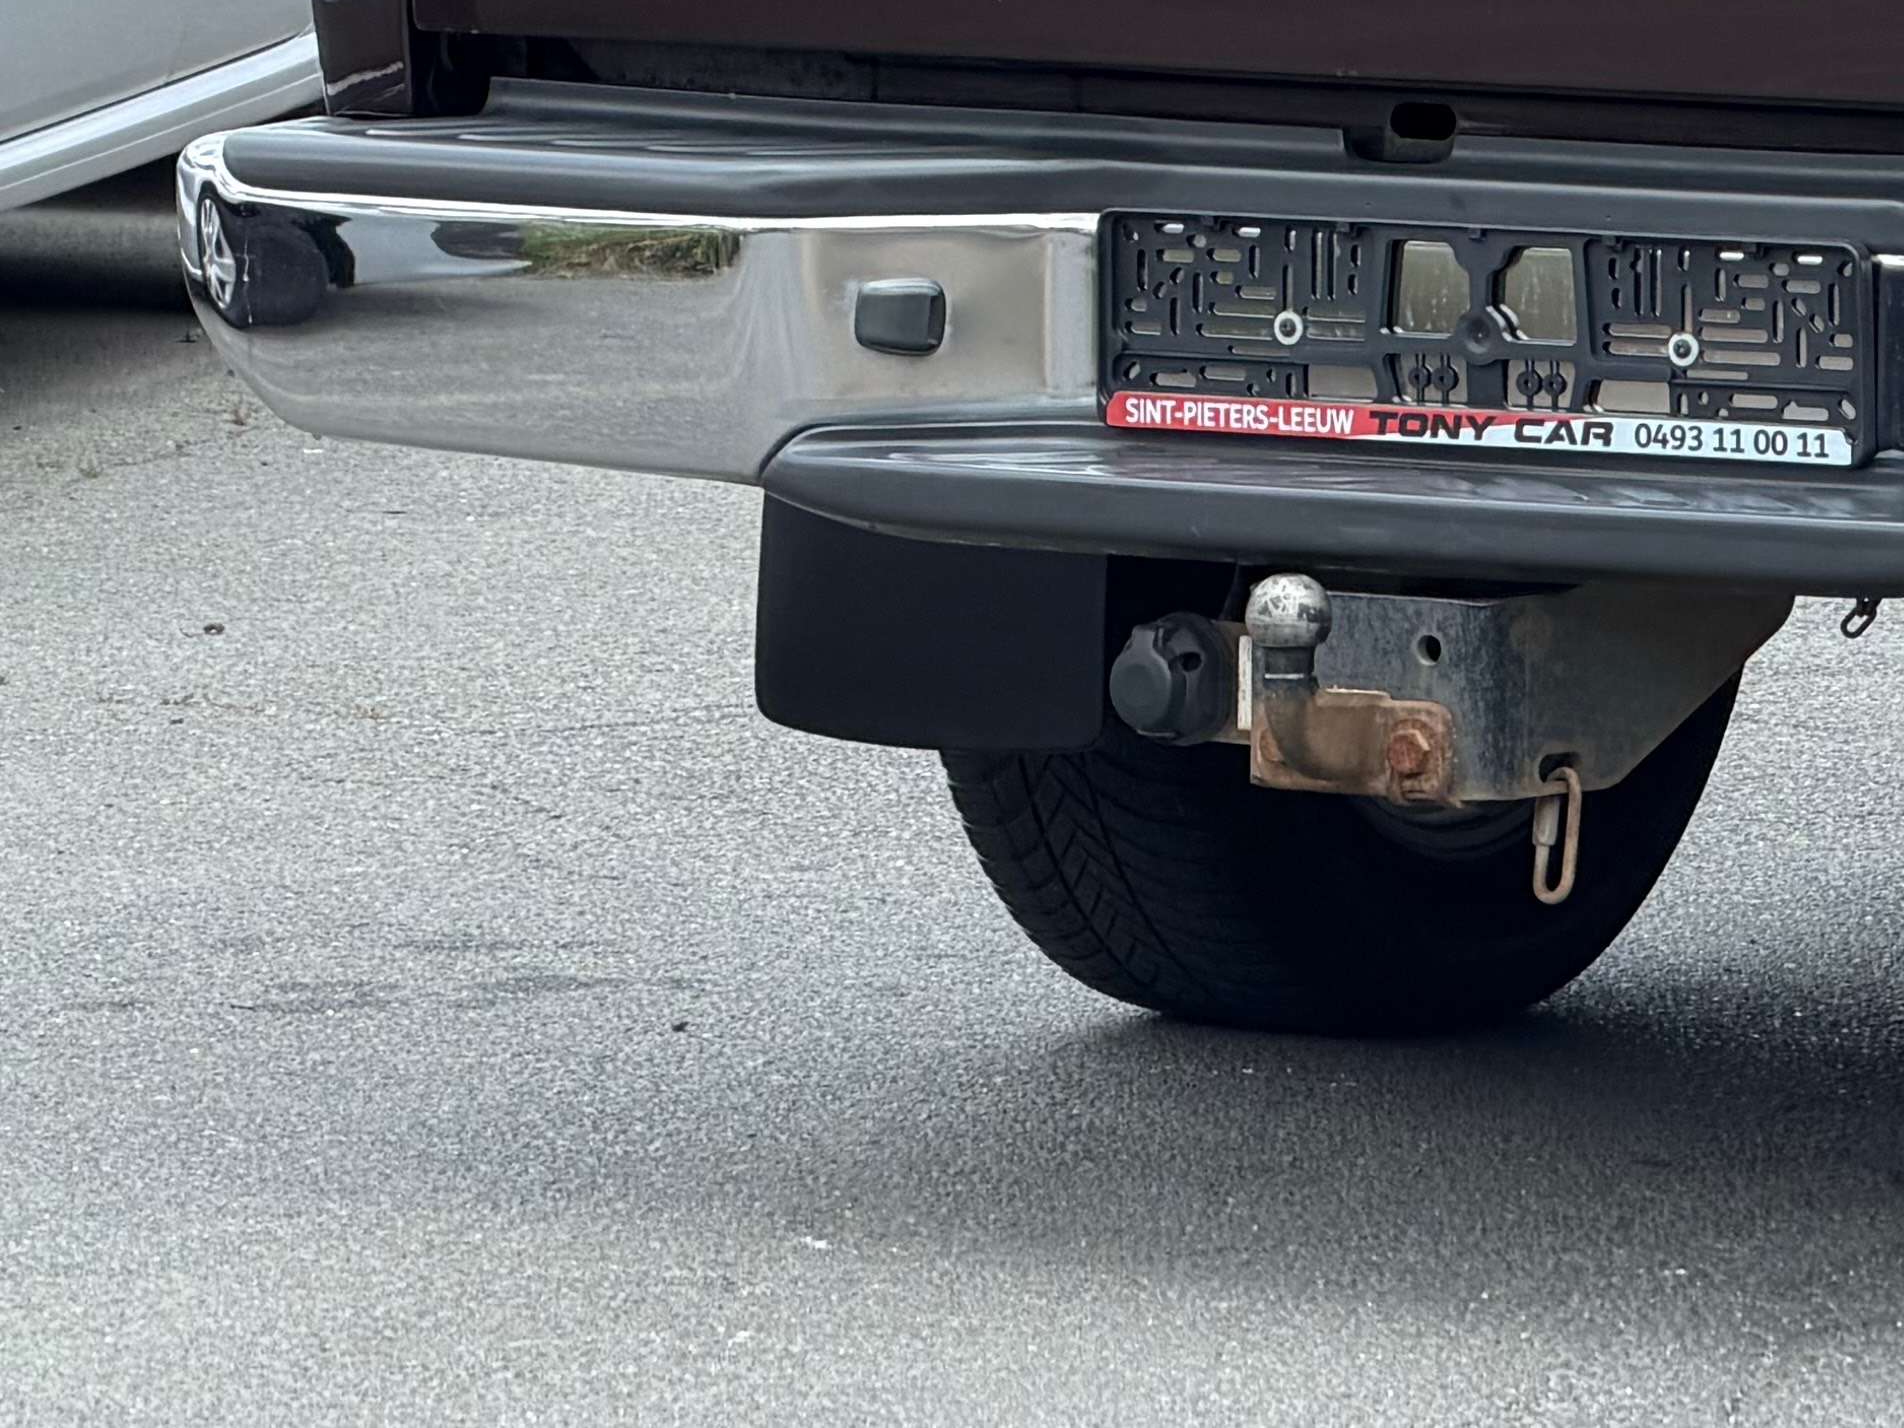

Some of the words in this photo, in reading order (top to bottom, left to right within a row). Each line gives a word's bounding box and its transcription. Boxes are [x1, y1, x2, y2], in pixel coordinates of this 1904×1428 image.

[1125, 397, 1354, 435] SINT-PIETERS-LEEUW
[1369, 410, 1499, 441] TONY
[1514, 418, 1614, 446] CAR
[1634, 422, 1704, 450] 0493
[1712, 428, 1745, 454] 11
[1754, 430, 1788, 456] 00
[1796, 432, 1830, 458] 11
